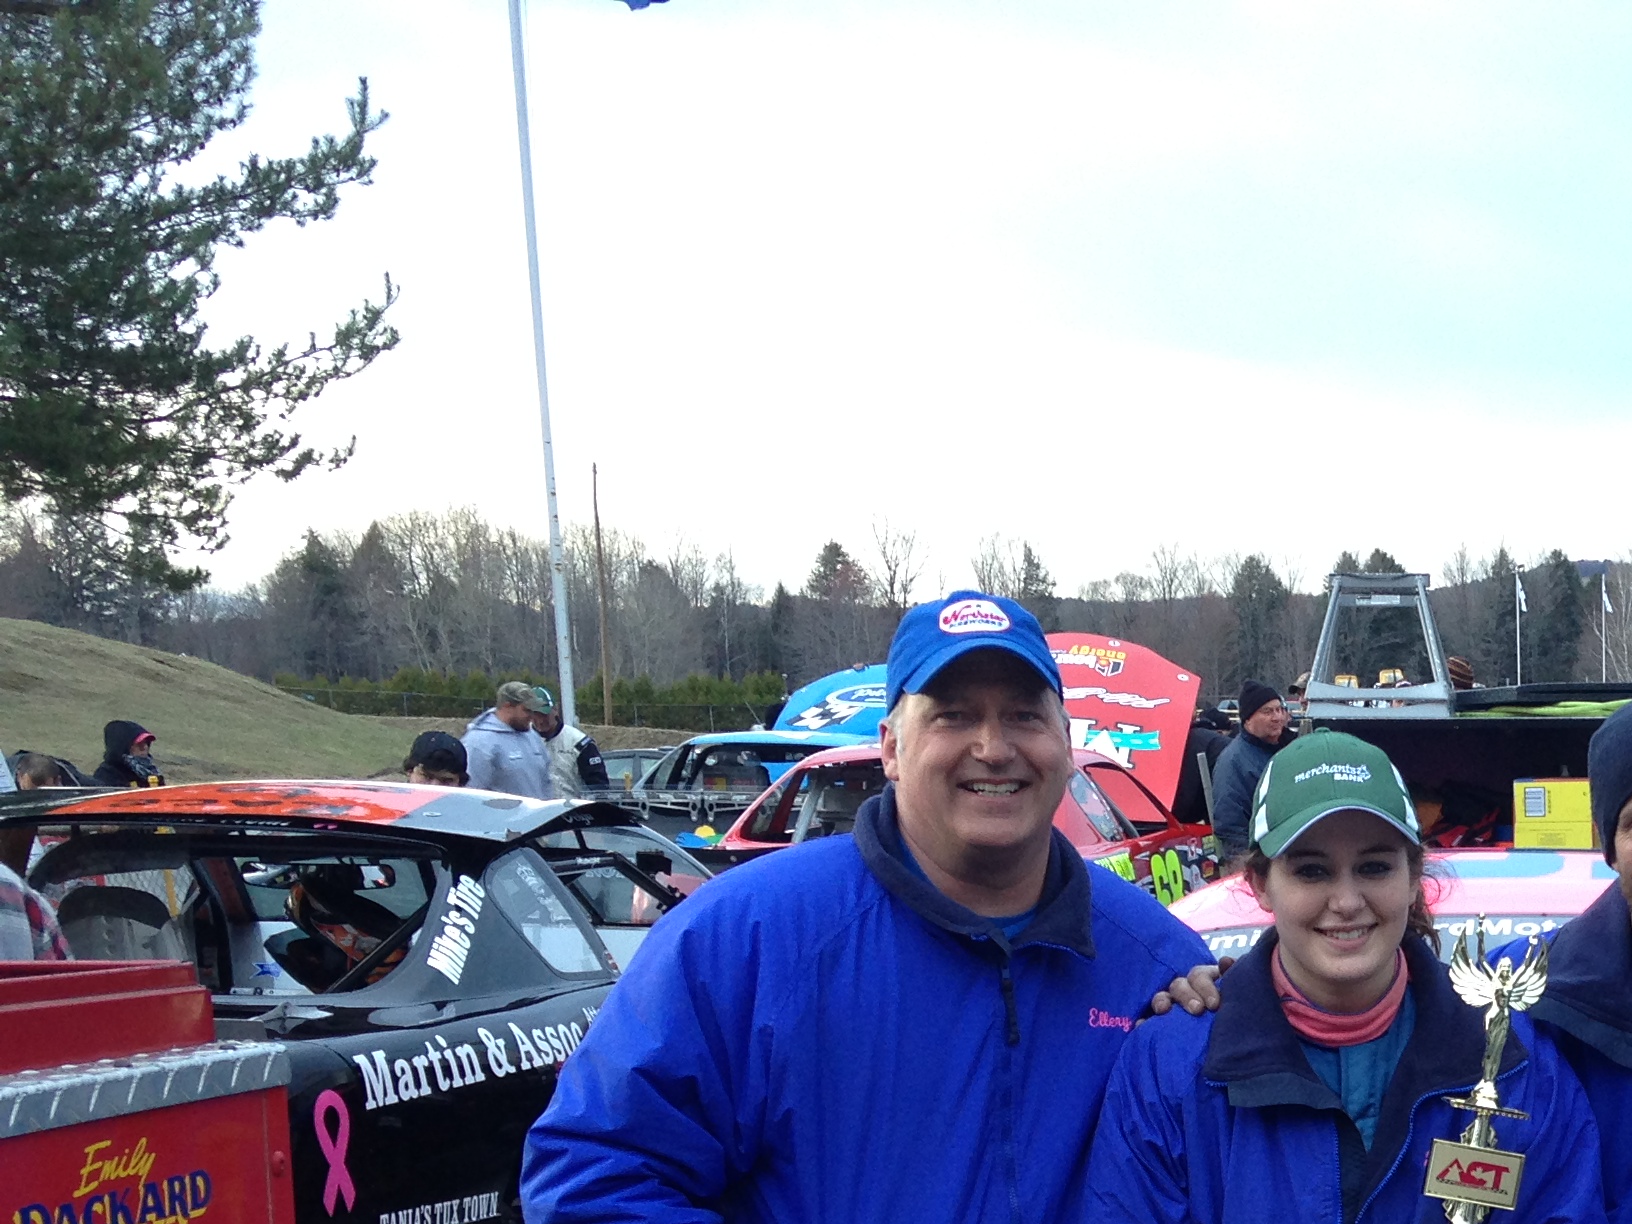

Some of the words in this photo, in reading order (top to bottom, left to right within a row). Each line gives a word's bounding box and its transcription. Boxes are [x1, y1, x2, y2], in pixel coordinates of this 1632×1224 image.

[1294, 763, 1358, 784] merchants
[1333, 773, 1364, 783] BANK
[447, 874, 486, 921] Tire
[427, 909, 476, 986] Mike's
[353, 1034, 487, 1111] Martin
[477, 1027, 517, 1078] &
[72, 1137, 157, 1198] Emily
[1435, 1157, 1511, 1190] ACT
[462, 1191, 501, 1223] TOWN
